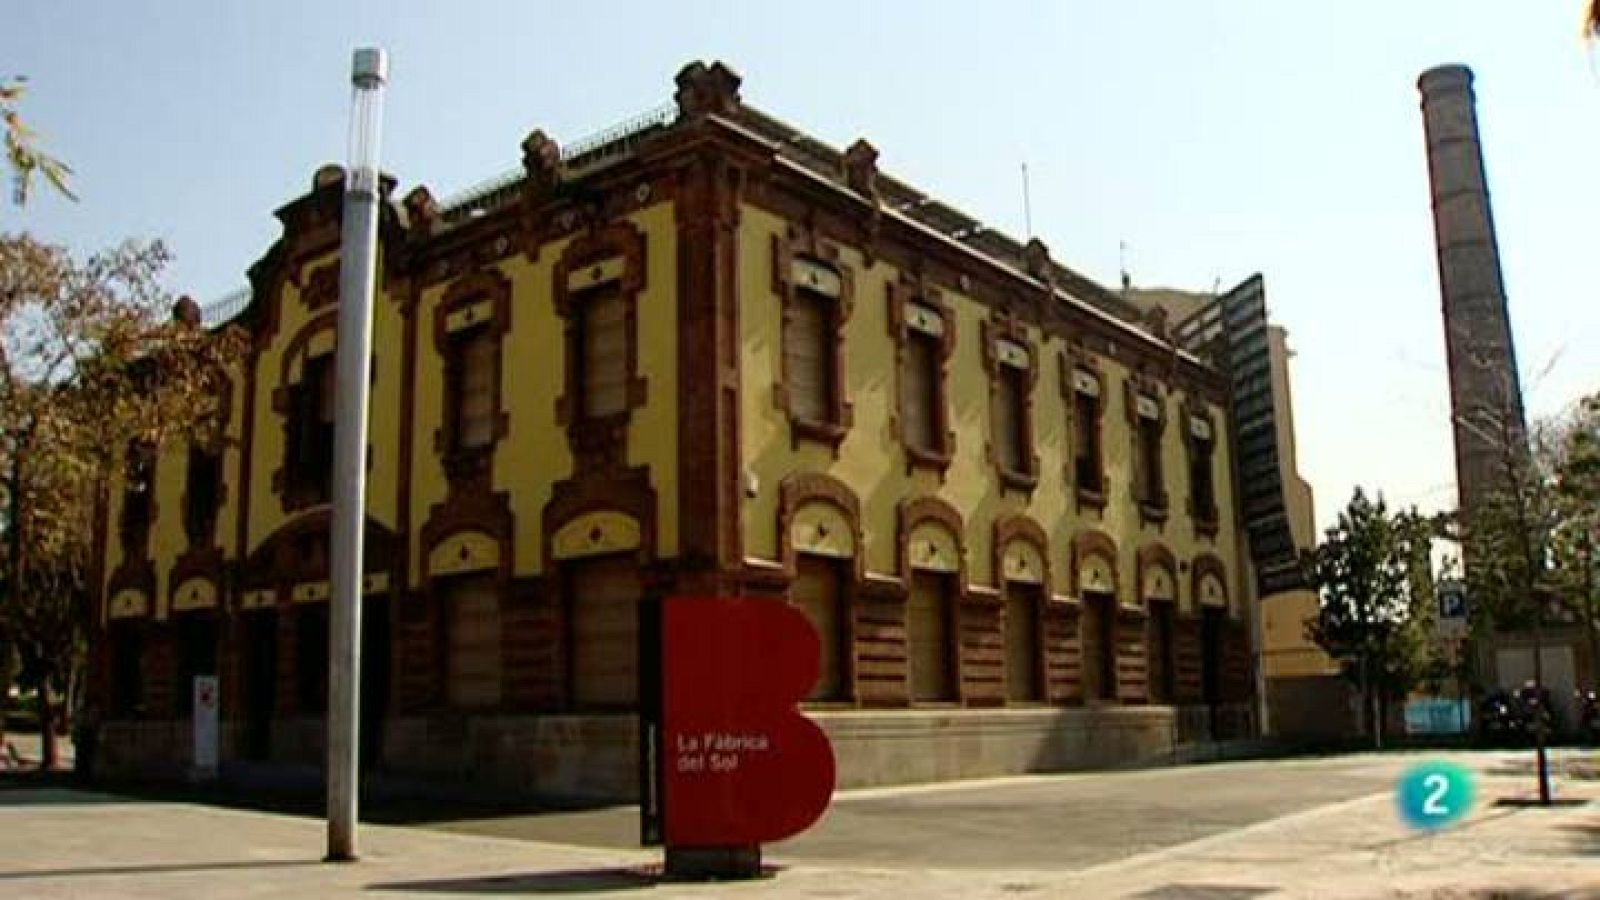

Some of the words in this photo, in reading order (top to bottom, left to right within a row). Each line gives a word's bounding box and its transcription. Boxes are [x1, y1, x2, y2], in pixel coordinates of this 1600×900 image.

[677, 733, 699, 751] La
[677, 753, 703, 773] del
[710, 753, 738, 773] Sol
